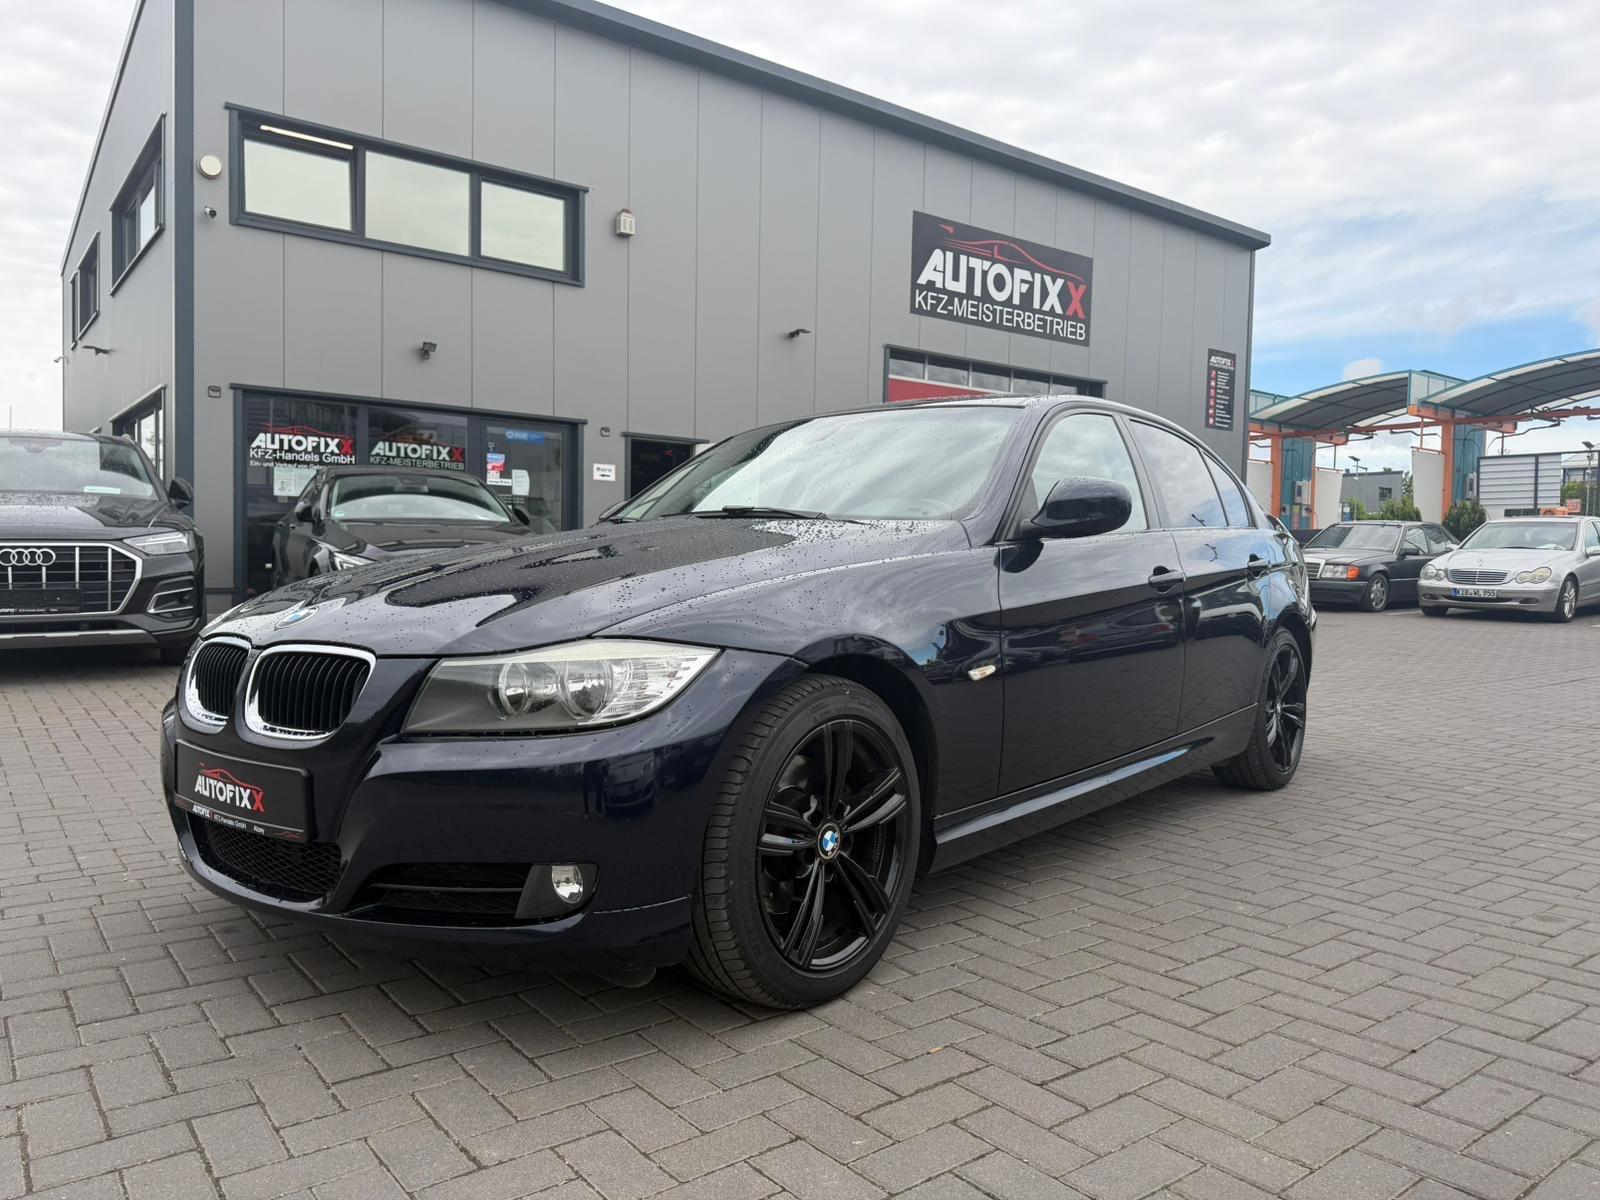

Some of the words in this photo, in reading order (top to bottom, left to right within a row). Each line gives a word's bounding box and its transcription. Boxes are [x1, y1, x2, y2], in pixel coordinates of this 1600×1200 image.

[917, 248, 1087, 320] AUTOFIXX
[914, 289, 1086, 341] KFZ-MEISTERBETRIEB
[251, 432, 354, 456] AUTOFIXX
[371, 441, 464, 463] AUTOFIXX
[249, 448, 320, 463] KFZ-Handels
[322, 453, 356, 465] GmbH
[369, 455, 465, 471] KFZ-MEISTERBETRIEB
[194, 774, 265, 813] AUTOFIXX
